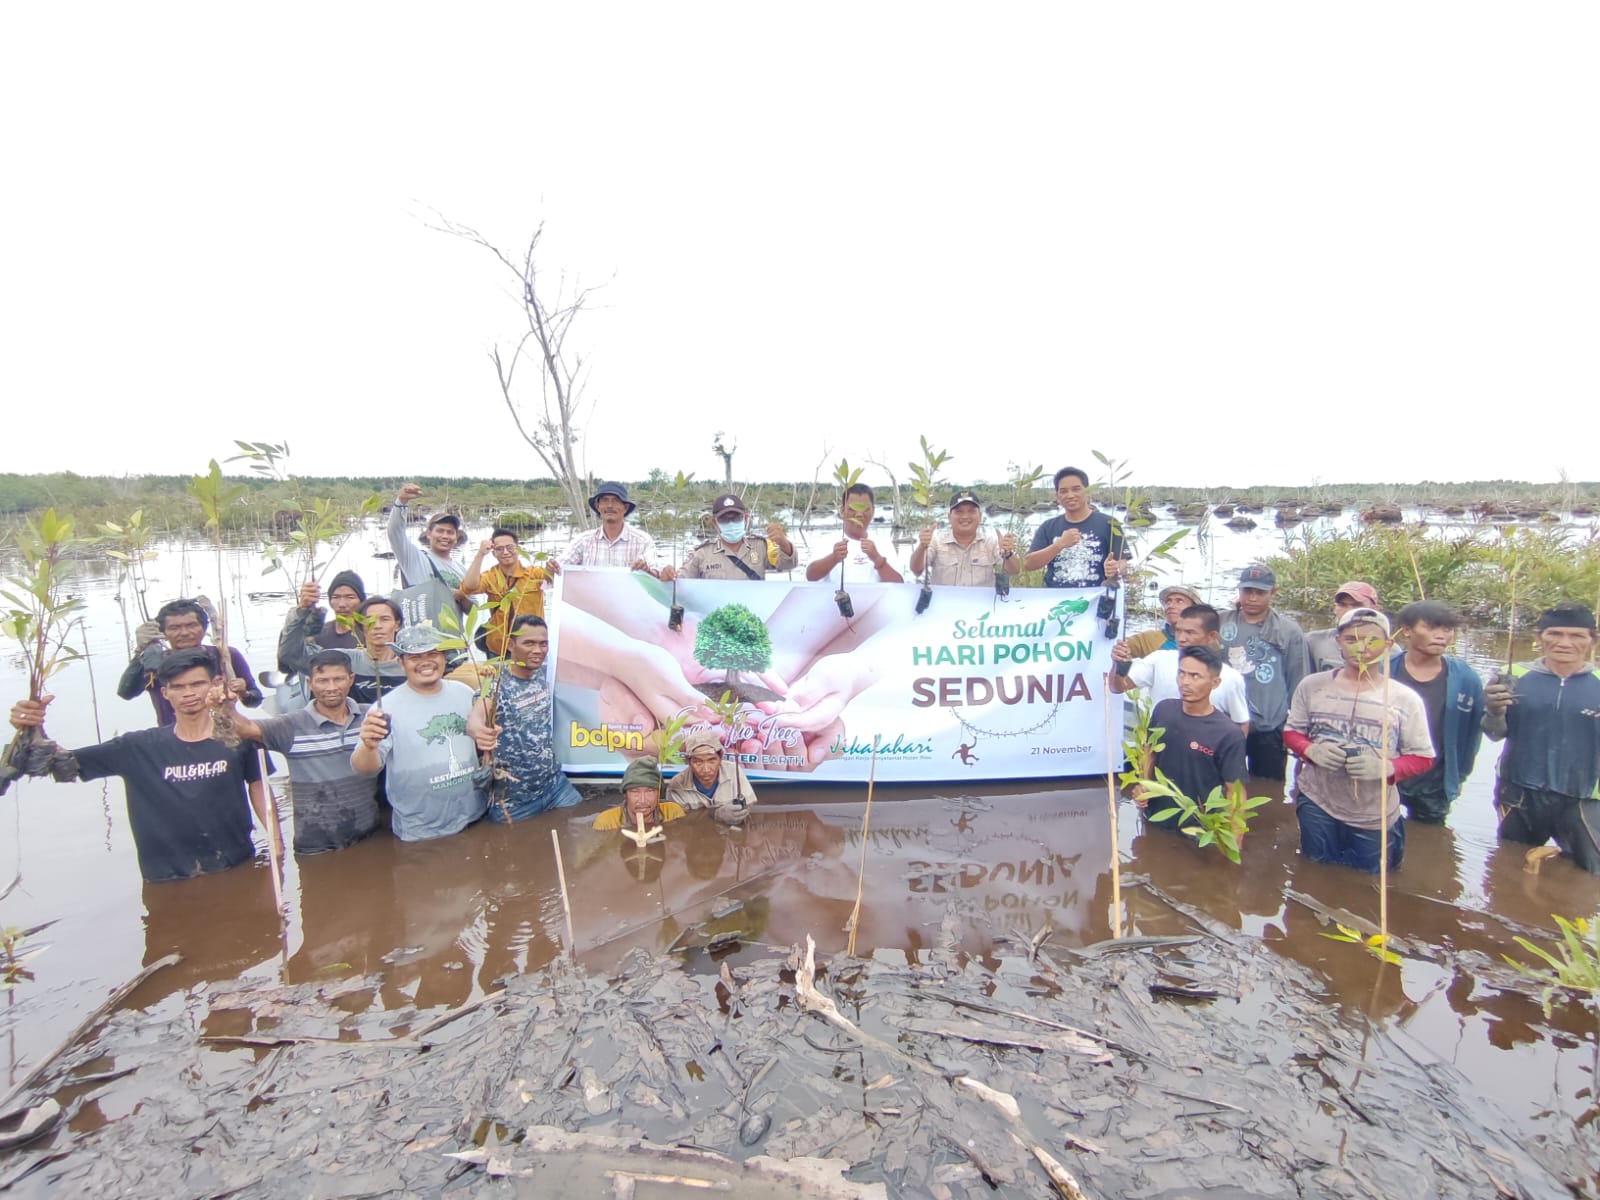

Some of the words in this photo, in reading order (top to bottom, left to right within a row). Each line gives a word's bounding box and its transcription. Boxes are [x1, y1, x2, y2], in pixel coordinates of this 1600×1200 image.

[952, 616, 1046, 640] Selamat
[912, 644, 985, 666] HARI
[993, 640, 1093, 664] POHON
[911, 672, 1092, 708] SEDUNIA
[570, 720, 643, 753] bdpn
[759, 711, 803, 750] Trees
[761, 755, 805, 766] EARTH
[1031, 747, 1040, 755] 21
[1042, 745, 1092, 755] November
[164, 760, 228, 780] PULL&BEAR
[432, 774, 474, 790] MANGRO
